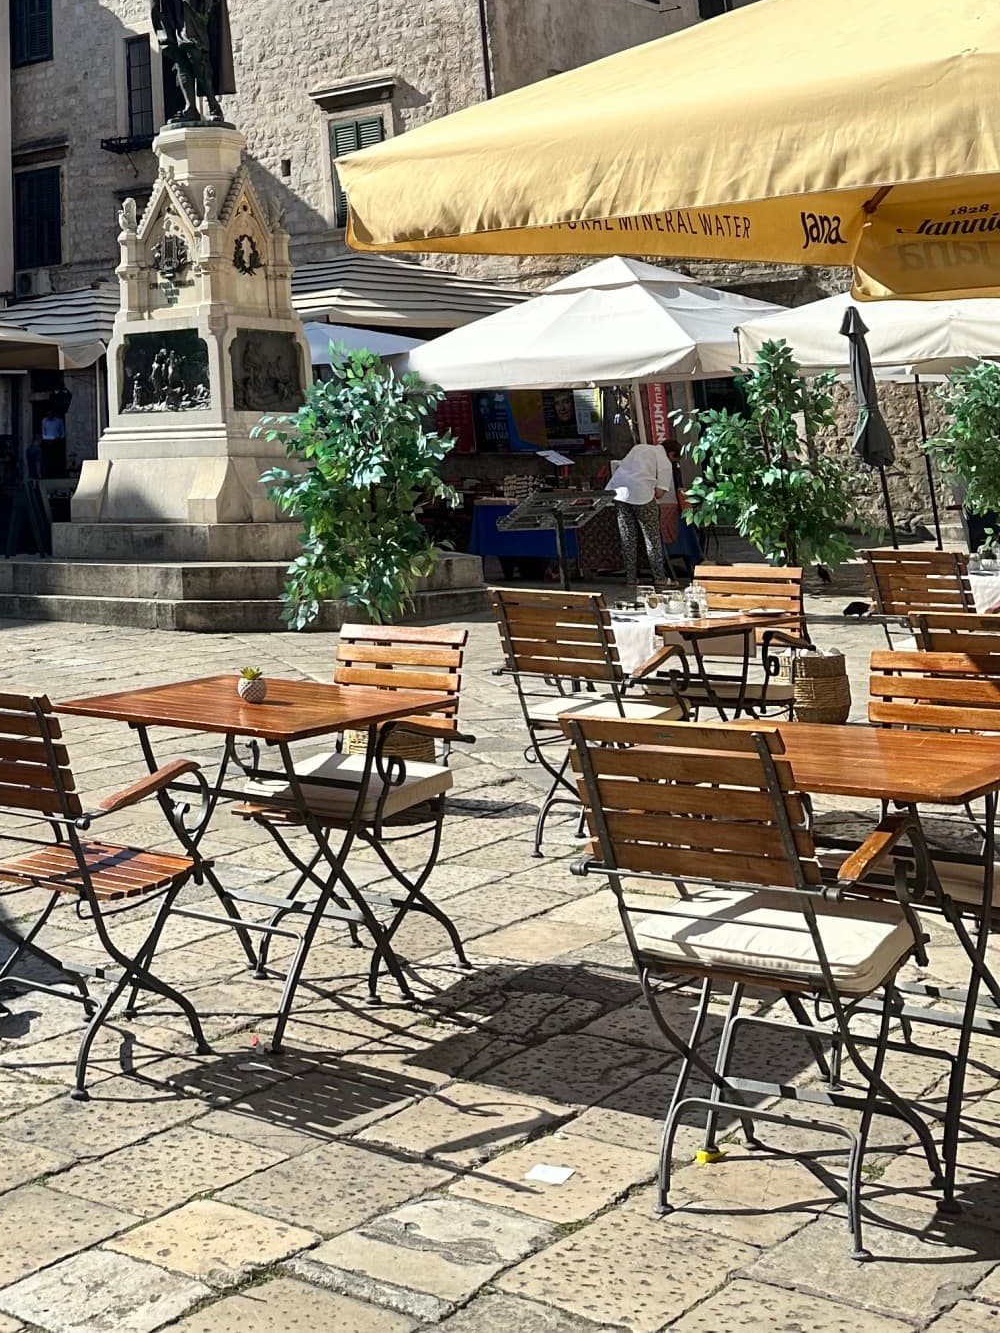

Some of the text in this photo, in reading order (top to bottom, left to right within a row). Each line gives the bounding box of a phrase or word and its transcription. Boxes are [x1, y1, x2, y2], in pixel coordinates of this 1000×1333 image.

[949, 203, 990, 215] 1828
[618, 210, 697, 235] MINERAL
[700, 214, 751, 238] WATER
[800, 212, 848, 249] Jana
